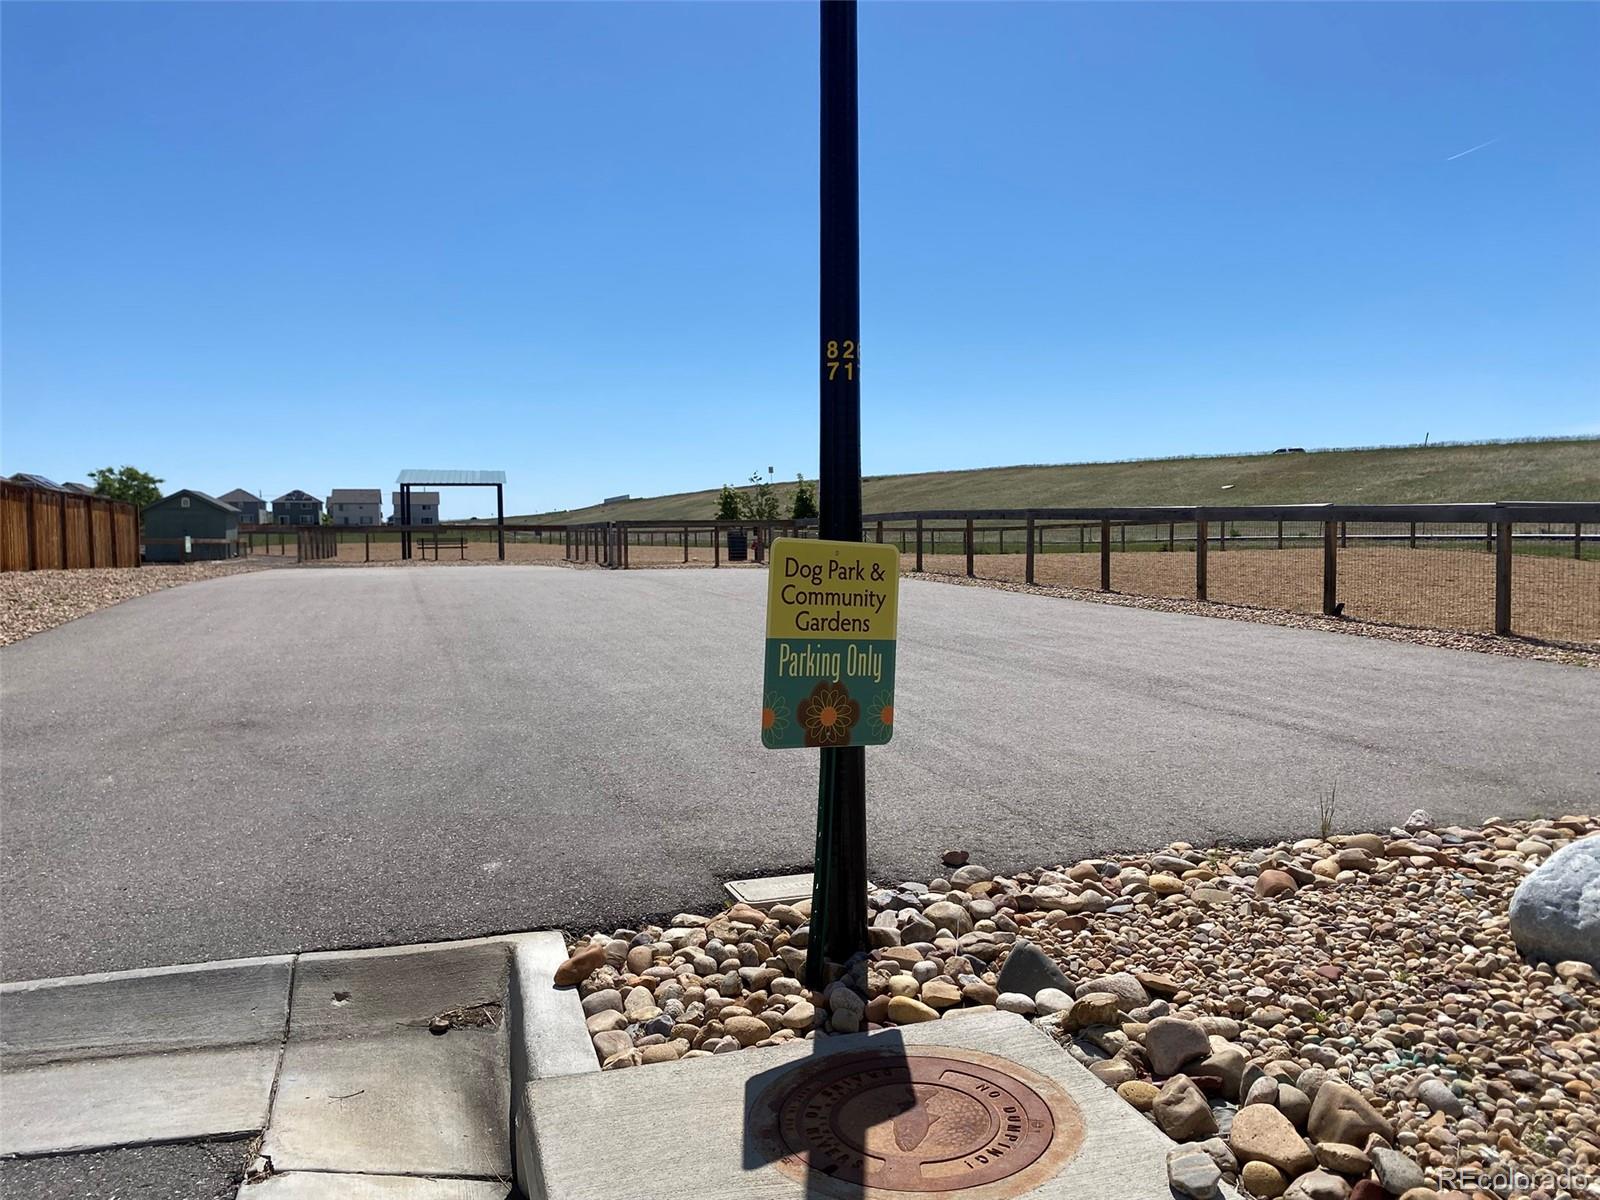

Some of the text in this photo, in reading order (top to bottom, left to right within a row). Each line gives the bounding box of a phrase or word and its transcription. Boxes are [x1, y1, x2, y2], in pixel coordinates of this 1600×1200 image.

[827, 362, 860, 380] 71
[785, 557, 885, 586] Dog Park &
[781, 584, 886, 614] Community
[795, 610, 870, 632] Gardens
[778, 643, 882, 684] Parking Only
[963, 1083, 1022, 1169] NO DUMPING!
